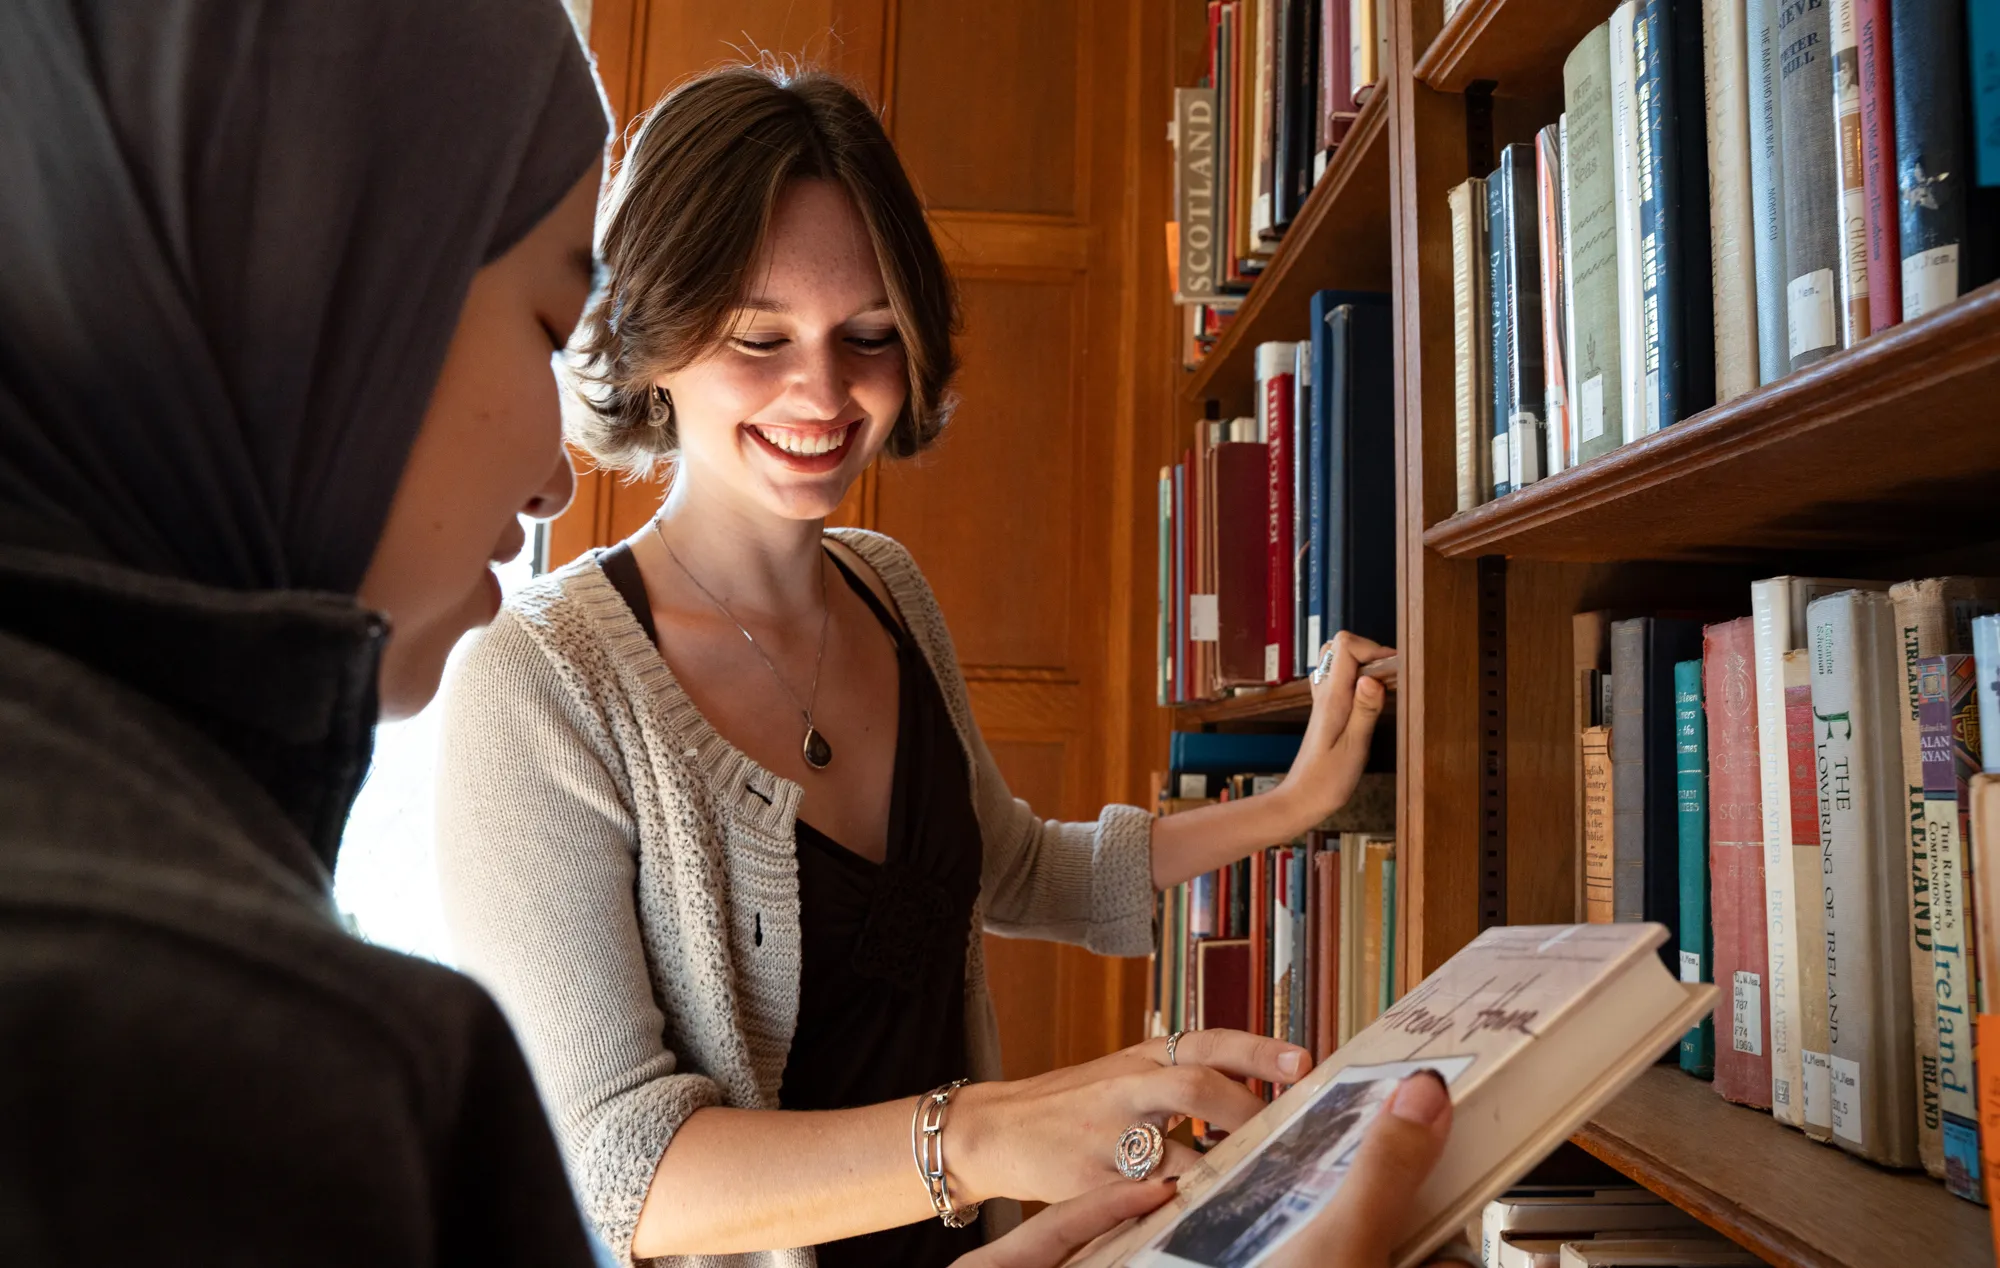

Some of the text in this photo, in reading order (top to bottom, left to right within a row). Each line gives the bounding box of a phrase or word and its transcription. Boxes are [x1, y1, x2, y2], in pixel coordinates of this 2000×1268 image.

[1783, 51, 1814, 80] BULL
[1862, 18, 1876, 95] WITNESS:
[1617, 80, 1629, 136] Finding
[1760, 26, 1775, 158] THE MAN WHO NEVER WAS
[1866, 98, 1877, 123] The
[1867, 123, 1880, 160] World
[1187, 99, 1213, 293] SCOTLAND
[1850, 217, 1868, 283] CHARLES
[1642, 232, 1660, 373] HANS HERLIN
[1269, 383, 1279, 434] THE
[1269, 438, 1281, 546] BOLSHOI
[1816, 626, 1825, 675] Scherman
[1904, 625, 1920, 721] L'IRLANDE
[1722, 725, 1759, 746] MRY
[1920, 735, 1950, 748] ALAN
[1921, 750, 1950, 762] RYAN
[1834, 756, 1851, 811] THE
[1908, 784, 1932, 953] IRELAND
[1929, 820, 1941, 931] COMPANION TO
[1941, 821, 1956, 929] THE READER'S
[1825, 887, 1835, 918] OF
[1735, 987, 1744, 997] DA
[1771, 889, 1787, 1053] ERIC LINKLATER
[1827, 930, 1838, 1044] IRELAND
[1735, 999, 1748, 1010] 787
[1735, 1026, 1748, 1038] F74
[1932, 939, 1968, 1094] Ireland
[1922, 1056, 1939, 1129] IRLAND
